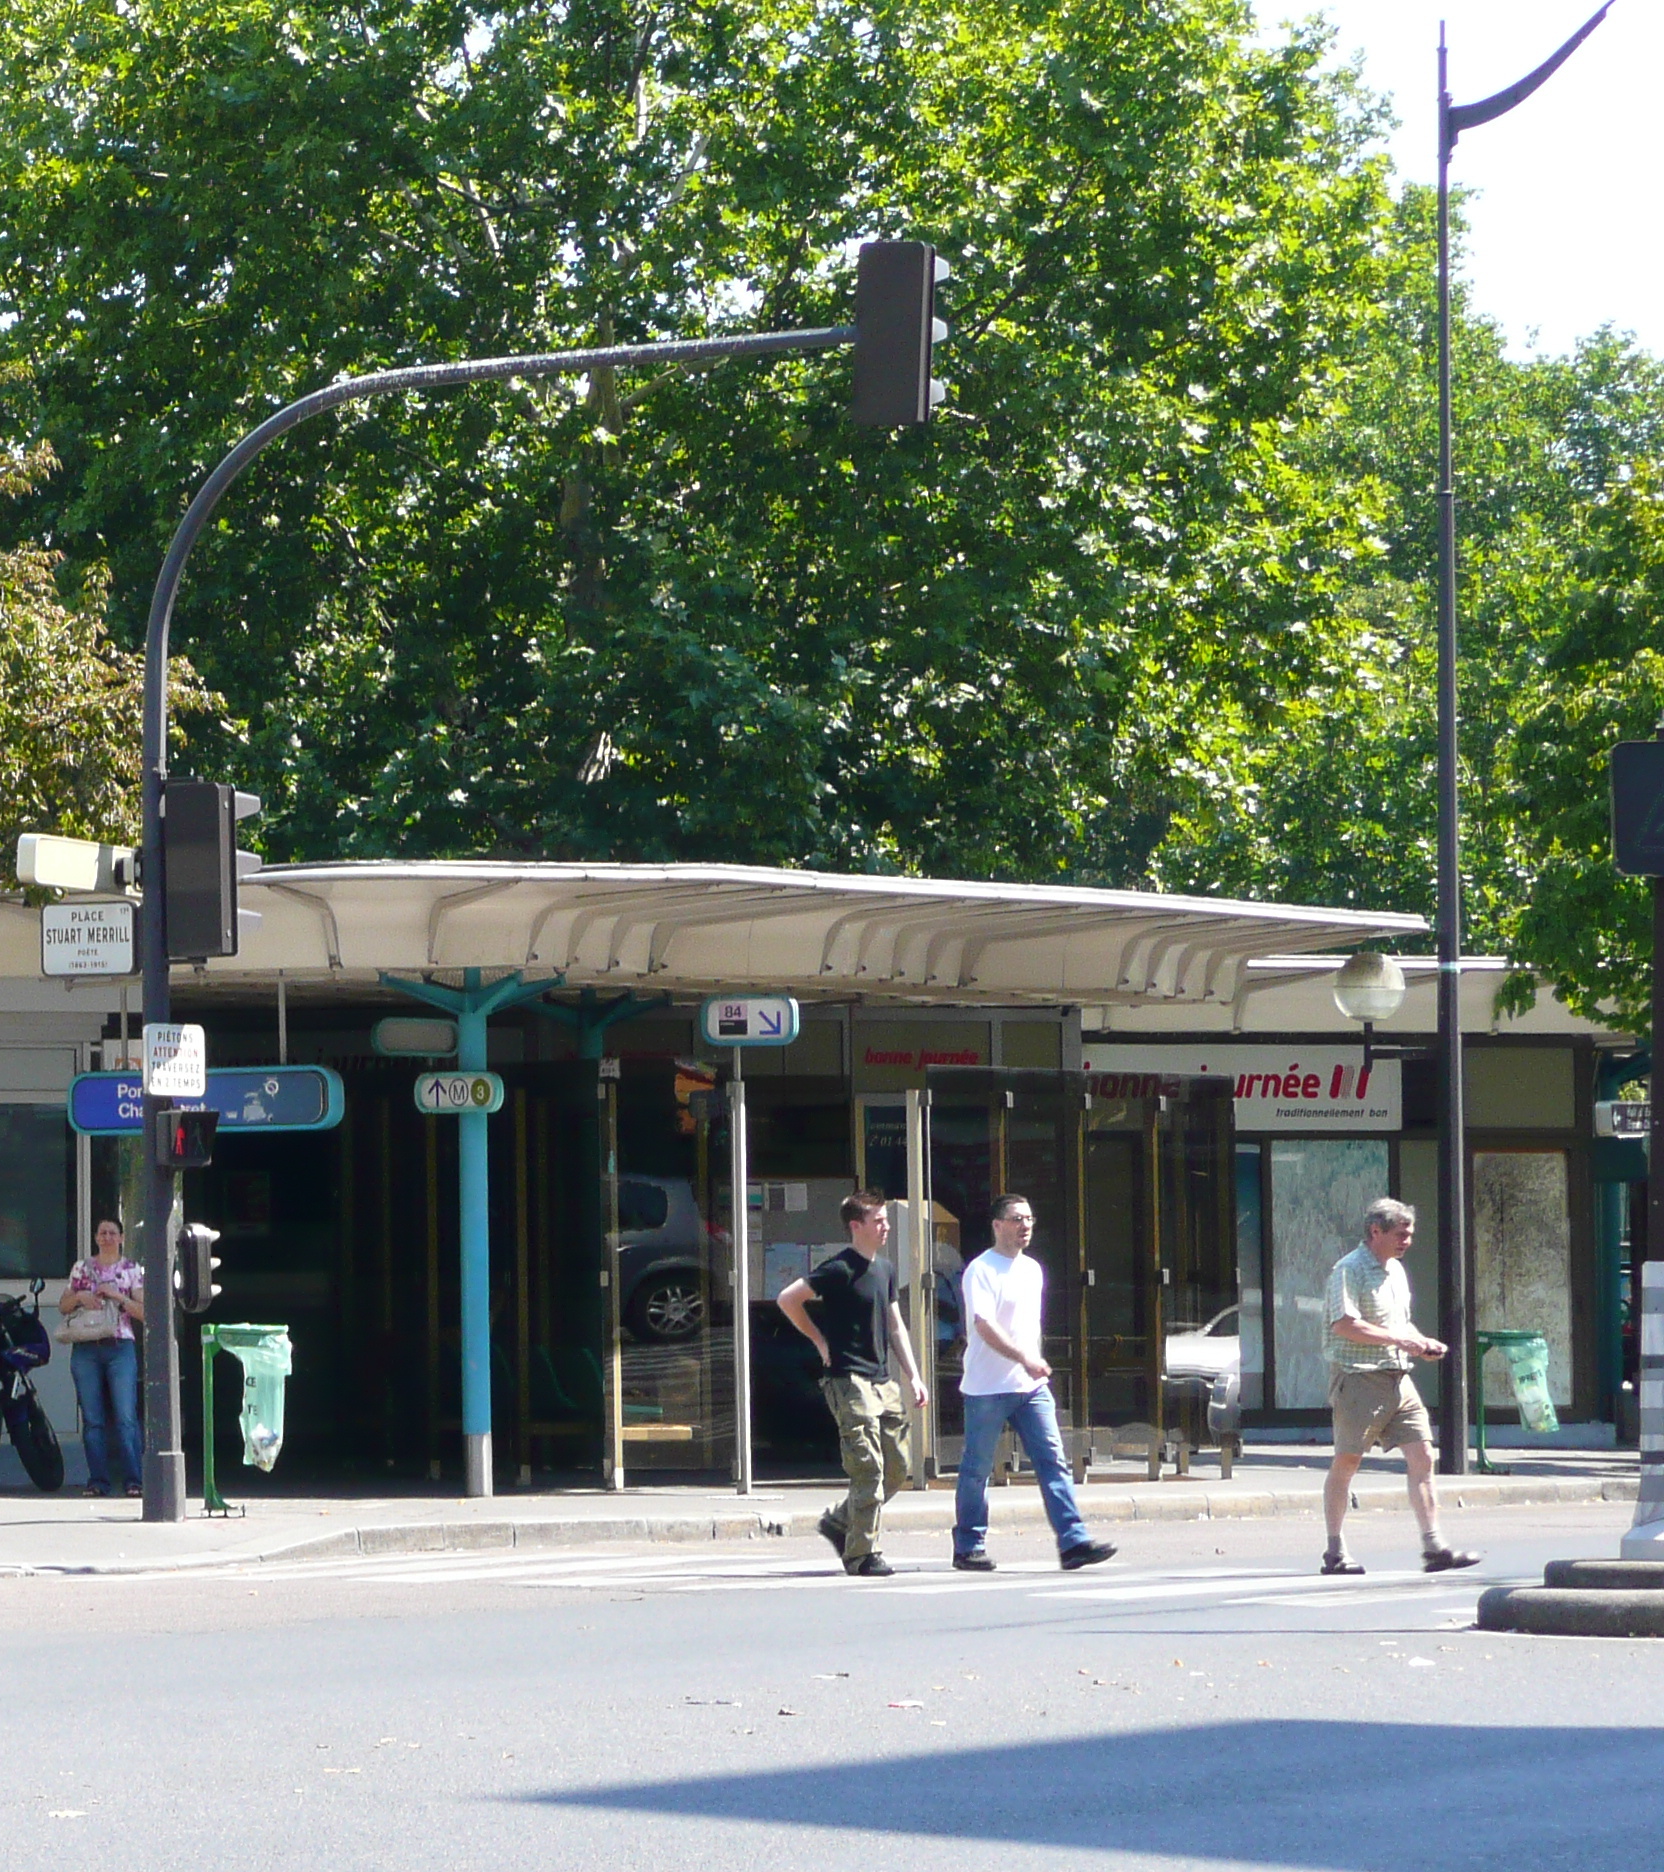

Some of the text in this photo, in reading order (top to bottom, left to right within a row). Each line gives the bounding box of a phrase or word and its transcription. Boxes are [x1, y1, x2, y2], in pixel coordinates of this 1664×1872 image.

[71, 911, 105, 922] PLACE
[46, 926, 130, 944] STUART MERRILL
[725, 1006, 742, 1018] 84
[157, 1031, 193, 1043] PIÉTONS
[152, 1061, 199, 1073] TRAVERSEZ
[173, 1078, 201, 1089] TEMPS
[477, 1085, 485, 1100] 3
[1276, 1108, 1388, 1118] traditionnellement bon
